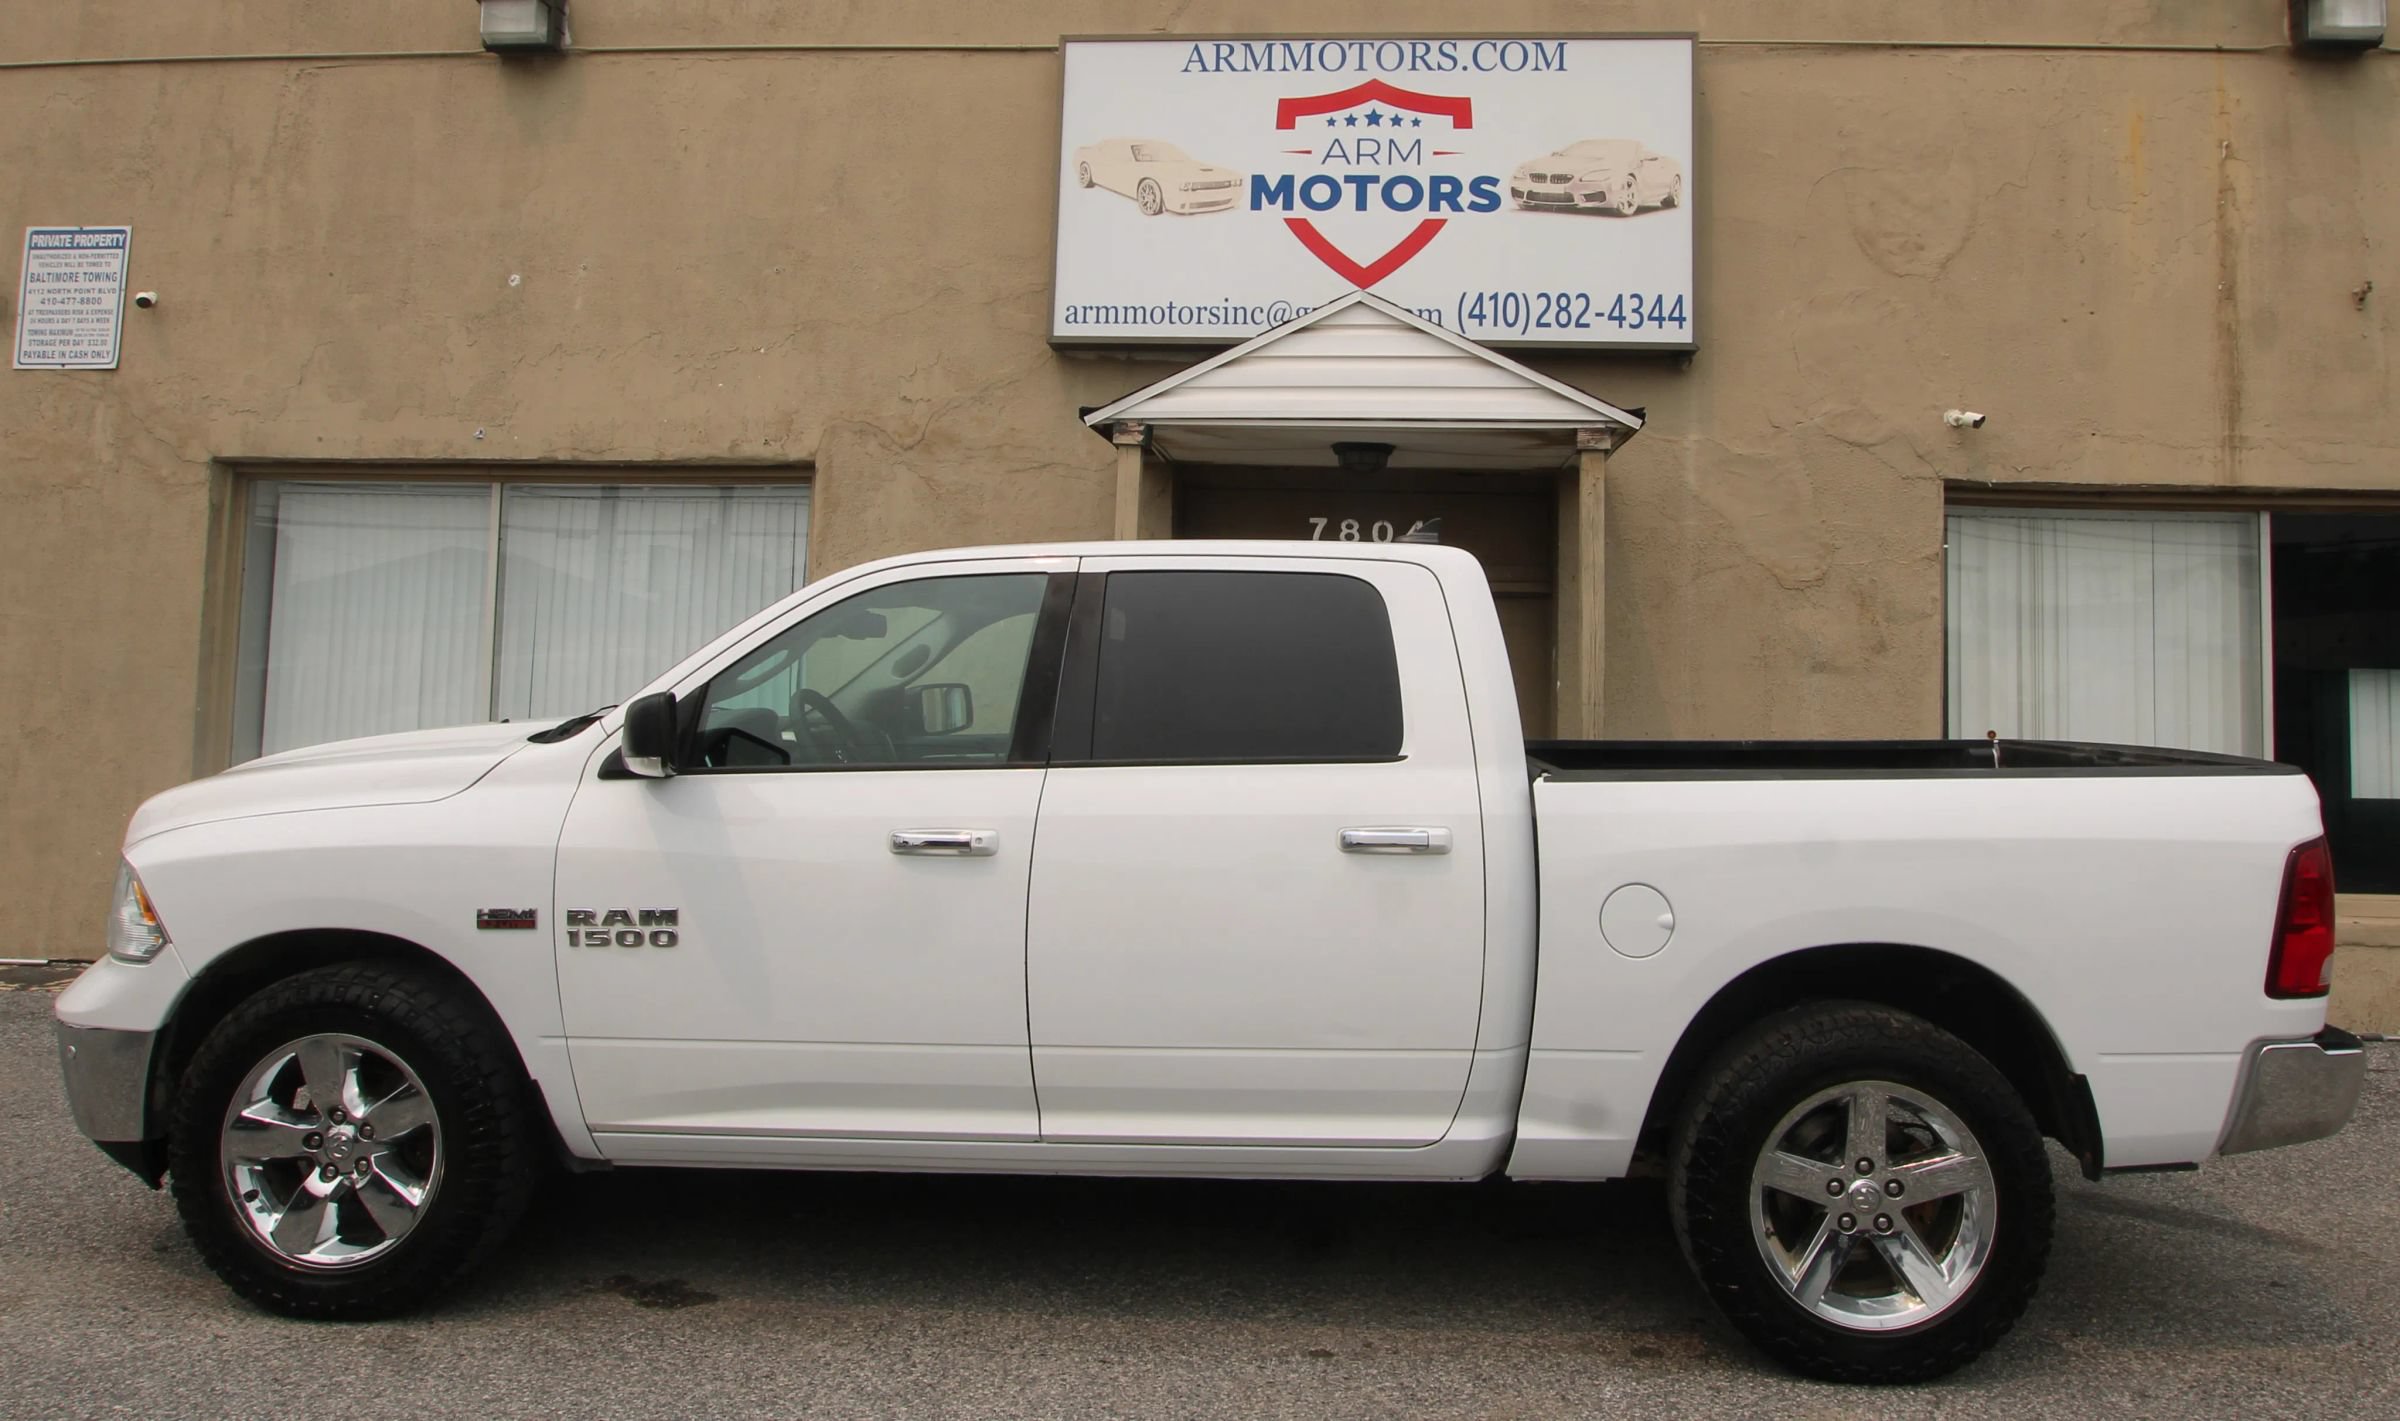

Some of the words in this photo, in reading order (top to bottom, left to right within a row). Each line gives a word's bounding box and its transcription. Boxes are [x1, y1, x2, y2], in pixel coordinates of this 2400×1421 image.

[1180, 41, 1568, 73] ARMMOTORS.COM
[1320, 138, 1422, 165] ARM
[1249, 173, 1502, 213] MOTORS
[31, 234, 73, 247] PRIVATE
[74, 233, 126, 247] PROPERTY
[30, 272, 80, 283] BALTIMORE
[82, 271, 118, 282] TOWING
[98, 287, 117, 295] BLVD
[40, 296, 103, 305] 410-477-8800
[1457, 291, 1687, 335] (410)282-4344
[28, 339, 57, 347] STORAGE
[58, 339, 71, 347] PER
[72, 339, 84, 347] DAY
[23, 350, 57, 359] PAYABLE
[58, 350, 67, 359] IN
[68, 350, 89, 359] CASH
[91, 350, 111, 359] ONLY
[566, 907, 680, 927] RAM
[566, 928, 680, 948] 1500
